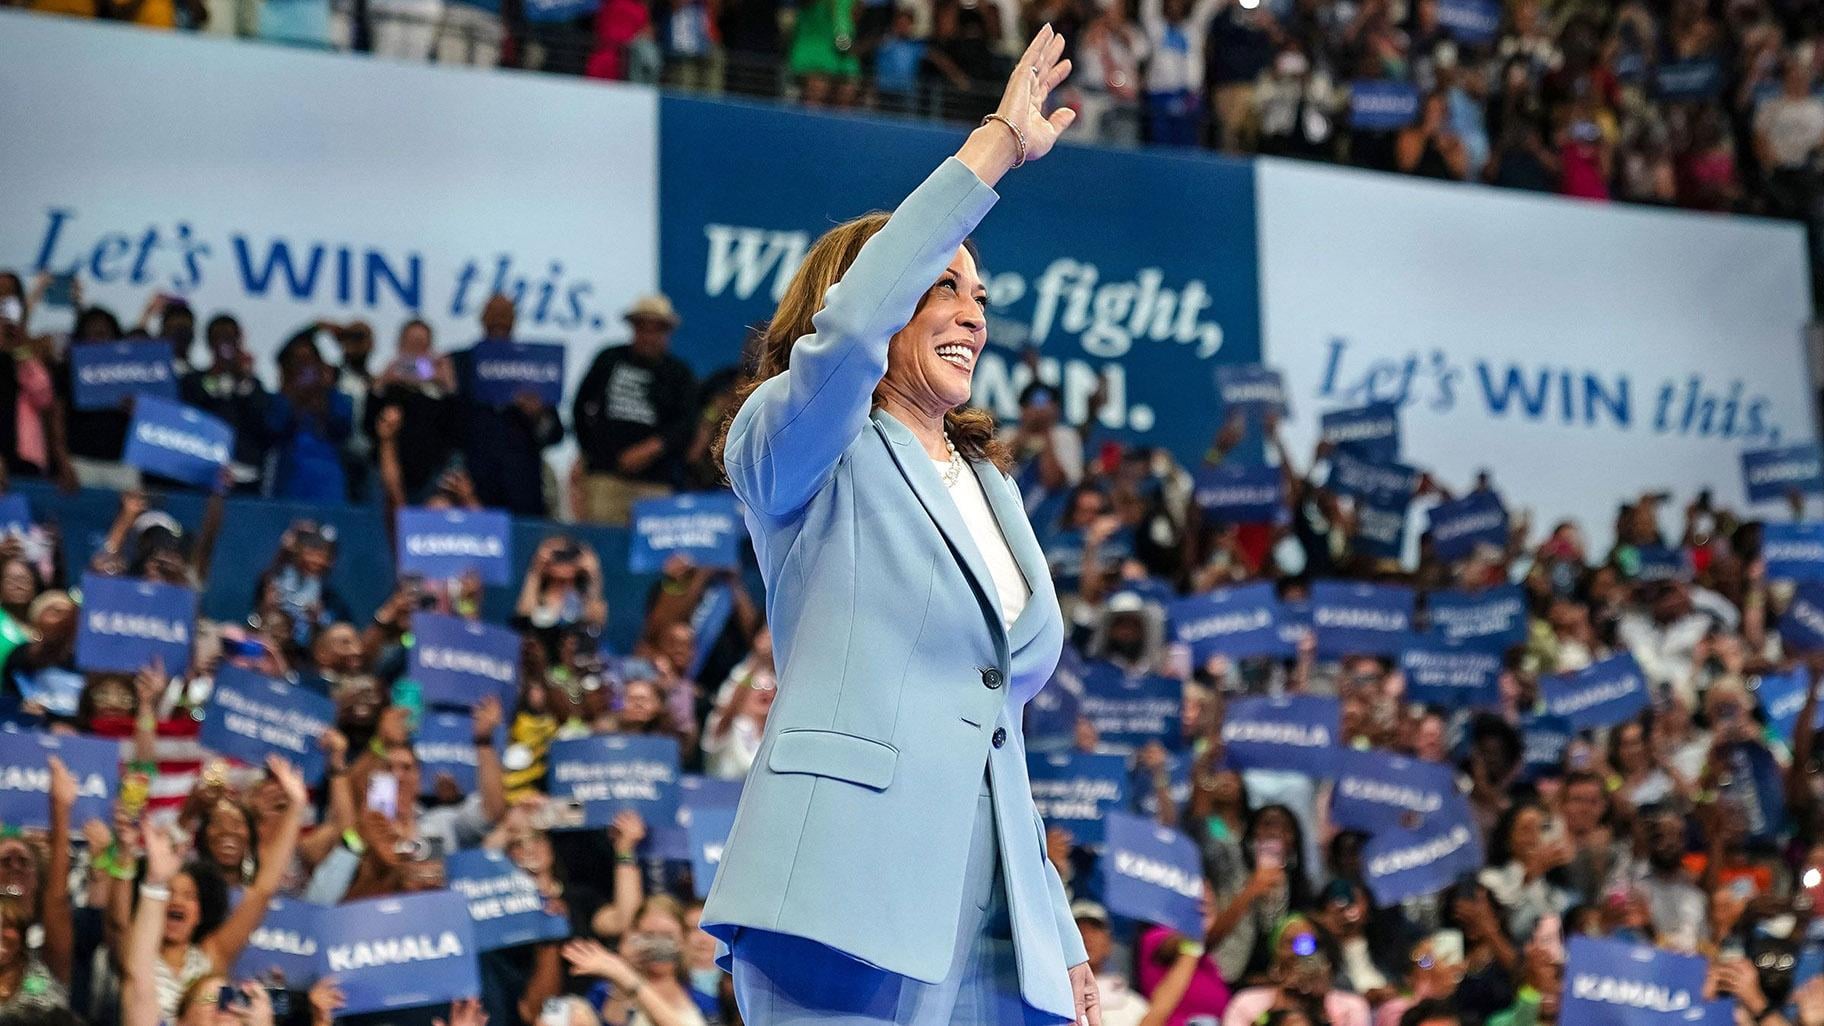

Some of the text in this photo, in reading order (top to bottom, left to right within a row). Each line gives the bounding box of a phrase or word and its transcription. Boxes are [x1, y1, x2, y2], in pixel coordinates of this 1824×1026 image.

[230, 233, 422, 311] WIN
[449, 252, 605, 331] this.
[1030, 257, 1224, 359] fight,
[1474, 360, 1631, 430] WIN
[405, 534, 505, 557] KAMALA
[88, 609, 189, 643] KAMALA
[1178, 606, 1272, 641] KAMALA
[1312, 607, 1408, 632] KAMALA
[418, 646, 517, 682] KAMALA
[1221, 721, 1331, 748] KAMALA
[1339, 774, 1443, 813] KAMALA
[1366, 825, 1473, 878] KAMALA
[326, 929, 464, 971] KAMALA
[1571, 971, 1692, 1014] KAMALA
